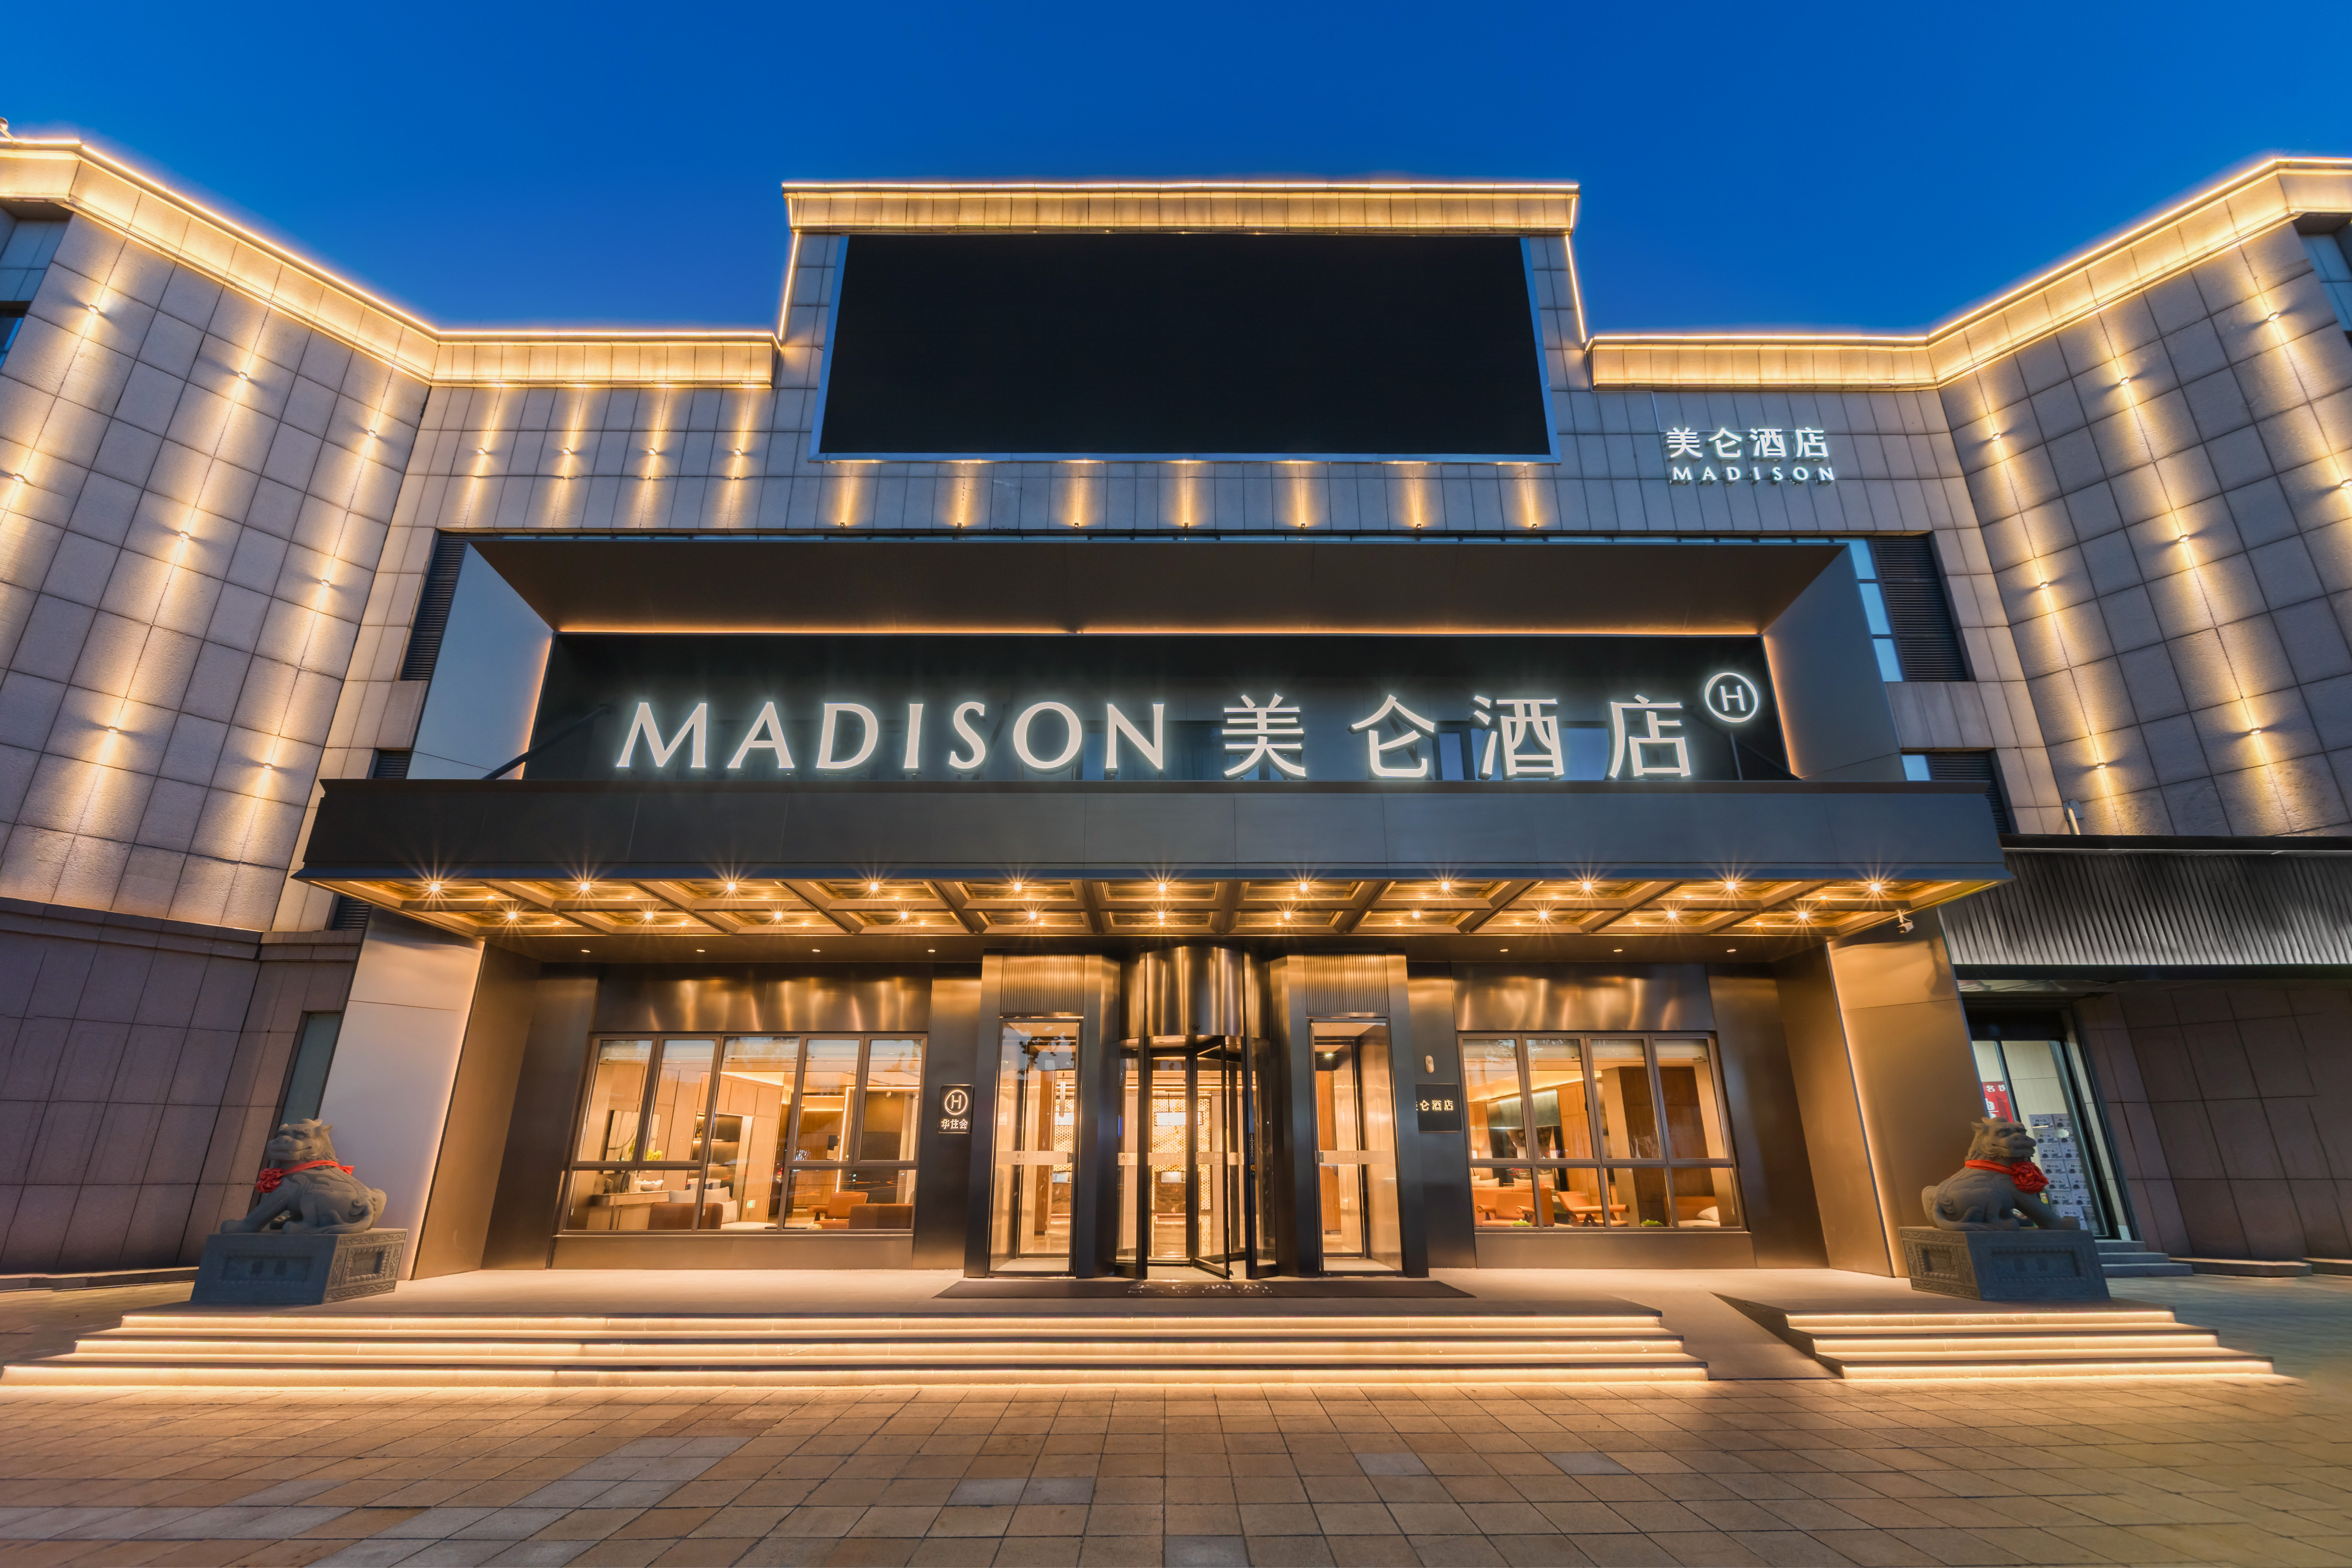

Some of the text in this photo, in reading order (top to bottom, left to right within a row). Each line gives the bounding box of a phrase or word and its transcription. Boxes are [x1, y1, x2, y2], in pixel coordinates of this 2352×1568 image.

[1666, 427, 1829, 458] 美仑酒店
[1673, 466, 1835, 481] MADISON
[616, 693, 1691, 778] MADISON 美仑酒店
[1416, 1099, 1454, 1111] 仑酒店
[941, 1118, 968, 1130] 华住会
